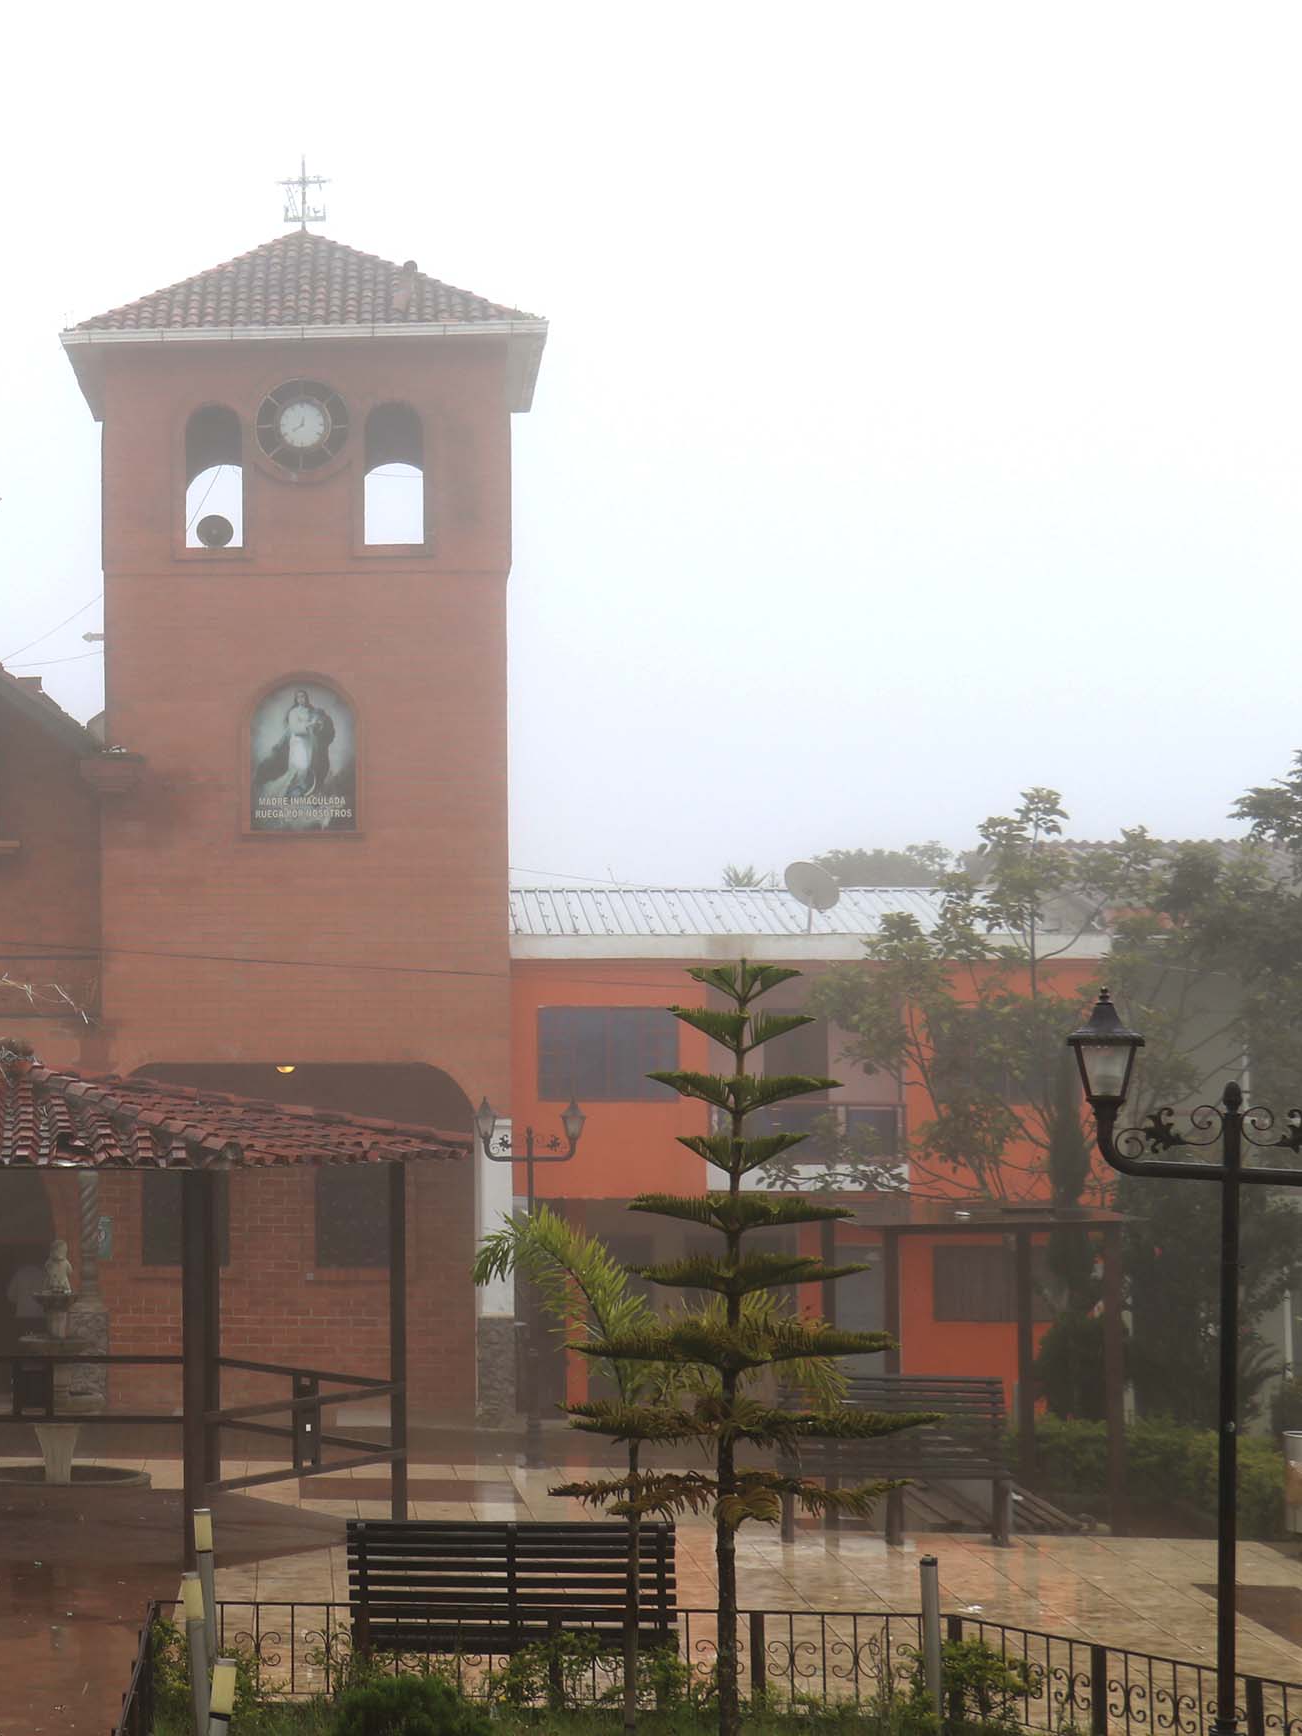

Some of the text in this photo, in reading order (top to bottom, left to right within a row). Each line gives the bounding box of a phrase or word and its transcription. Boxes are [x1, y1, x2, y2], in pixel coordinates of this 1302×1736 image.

[258, 796, 346, 806] MADRE INMACULADA
[255, 809, 284, 818] RUEGA
[305, 808, 353, 818] NOSOTROS
